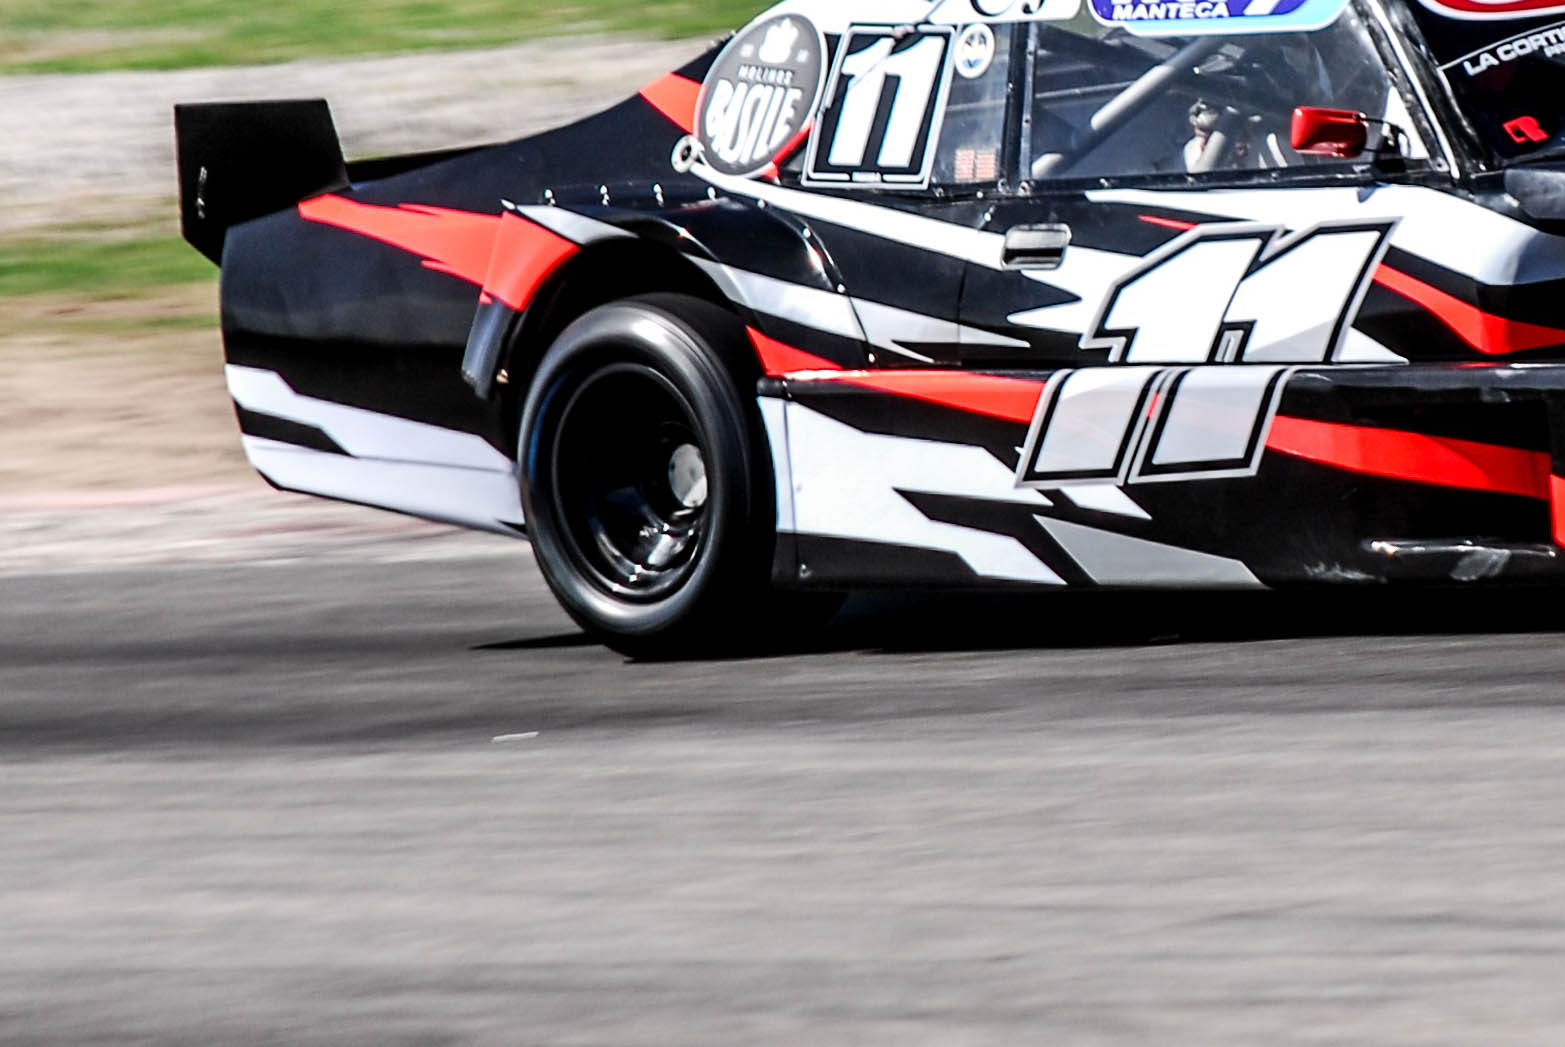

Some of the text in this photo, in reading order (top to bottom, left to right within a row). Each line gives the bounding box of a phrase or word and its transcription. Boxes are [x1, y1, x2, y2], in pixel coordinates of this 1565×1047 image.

[1112, 2, 1230, 21] MANTECA
[828, 35, 945, 167] 11
[1463, 52, 1500, 76] LA
[1017, 217, 1402, 487] 11
